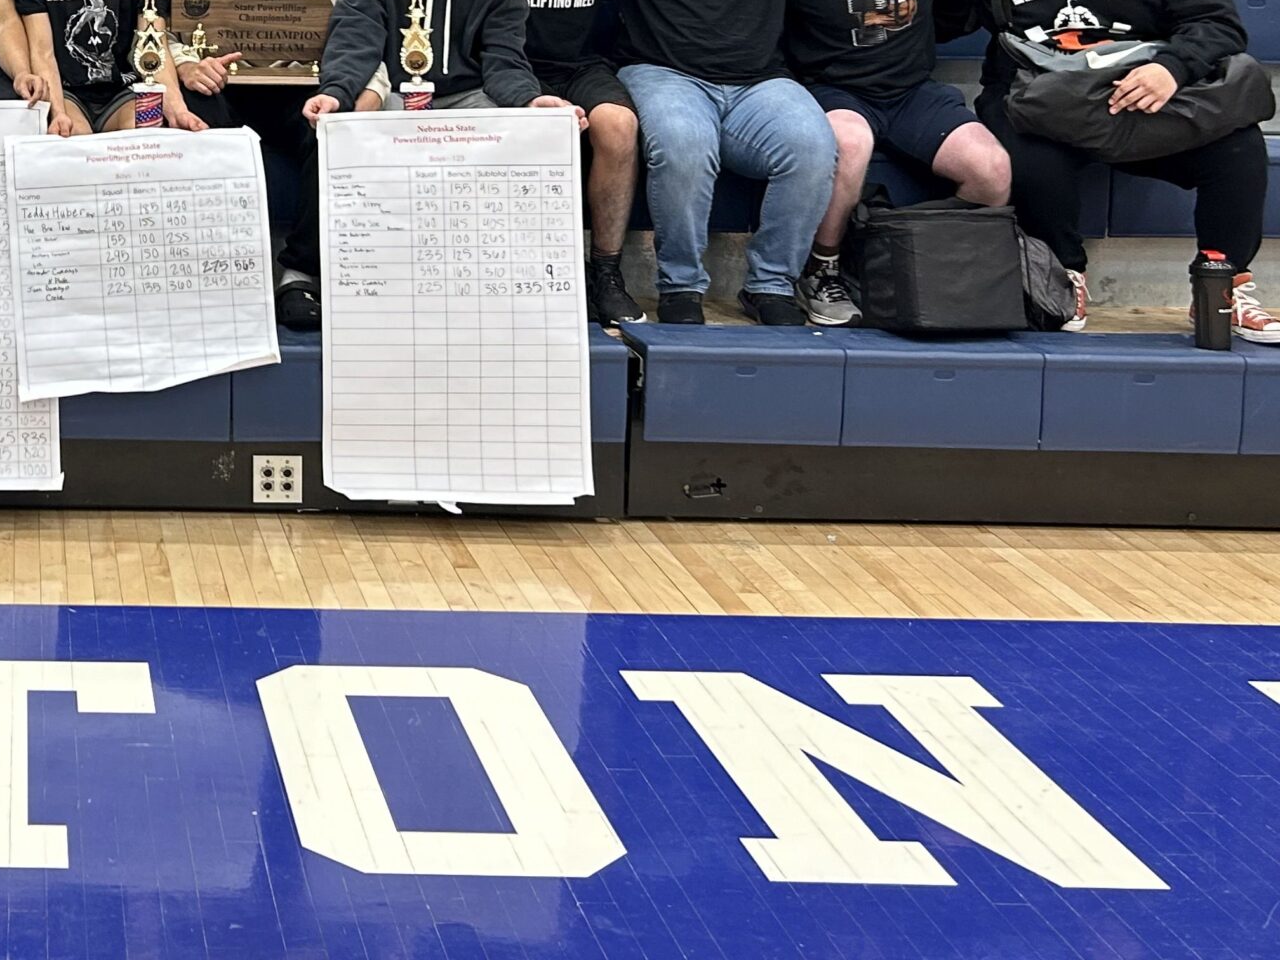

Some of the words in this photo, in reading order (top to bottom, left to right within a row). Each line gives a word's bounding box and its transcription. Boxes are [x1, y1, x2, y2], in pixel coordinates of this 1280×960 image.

[234, 3, 254, 11] State
[257, 3, 307, 14] Powerlifting
[238, 14, 302, 23] Championships
[217, 30, 253, 40] STATE
[257, 30, 321, 40] CHAMPION
[233, 42, 265, 52] MALE
[269, 43, 304, 52] TEAM
[417, 124, 454, 133] Nebraska
[455, 124, 476, 132] State
[393, 135, 441, 144] Powerlifting
[443, 134, 502, 143] Championship
[107, 143, 141, 152] Nebraska
[142, 142, 161, 150] State
[86, 153, 130, 163] Powerlifting
[131, 151, 183, 162] Championship
[477, 170, 507, 178] Subtotal
[510, 170, 539, 178] Deadlift
[22, 207, 50, 221] Teddy
[52, 204, 85, 218] Huber
[202, 259, 229, 274] 275
[514, 281, 542, 295] 335
[546, 281, 571, 292] 720
